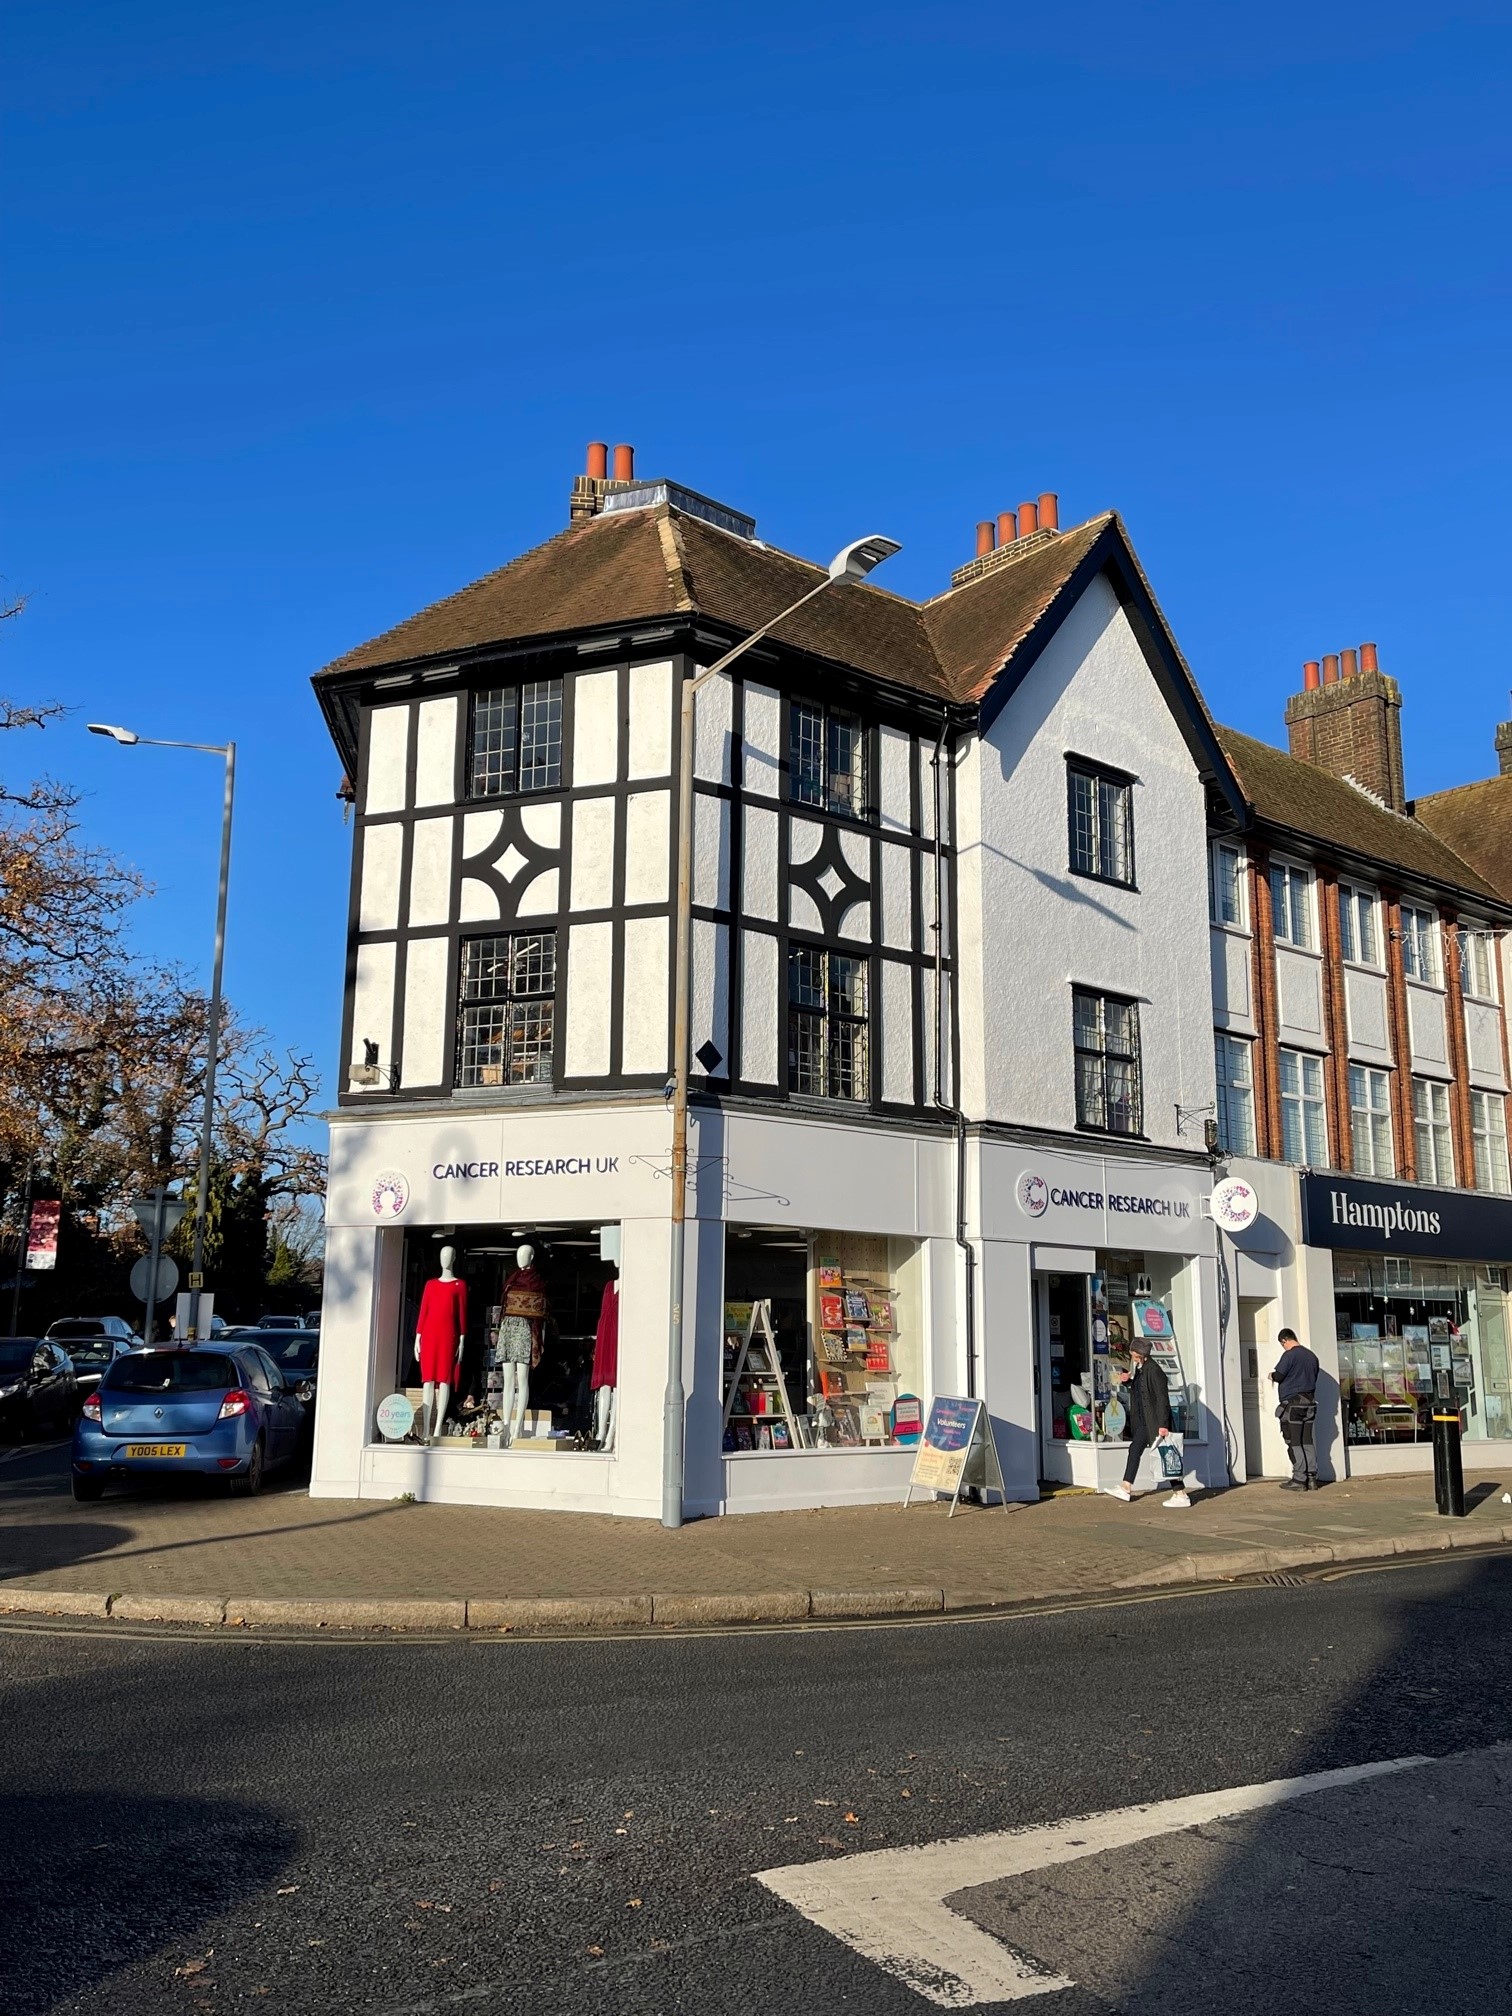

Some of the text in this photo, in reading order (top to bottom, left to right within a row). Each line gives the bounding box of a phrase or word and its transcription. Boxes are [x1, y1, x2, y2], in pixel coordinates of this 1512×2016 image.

[432, 1156, 620, 1180] CANCER RESEARCH UK
[1050, 1187, 1190, 1219] CANCER RESEARCH UK
[1330, 1191, 1441, 1239] Hamptons
[190, 1273, 202, 1287] H
[380, 1409, 411, 1420] 20 years
[937, 1417, 967, 1430] Volunteers
[160, 1446, 182, 1456] LEX
